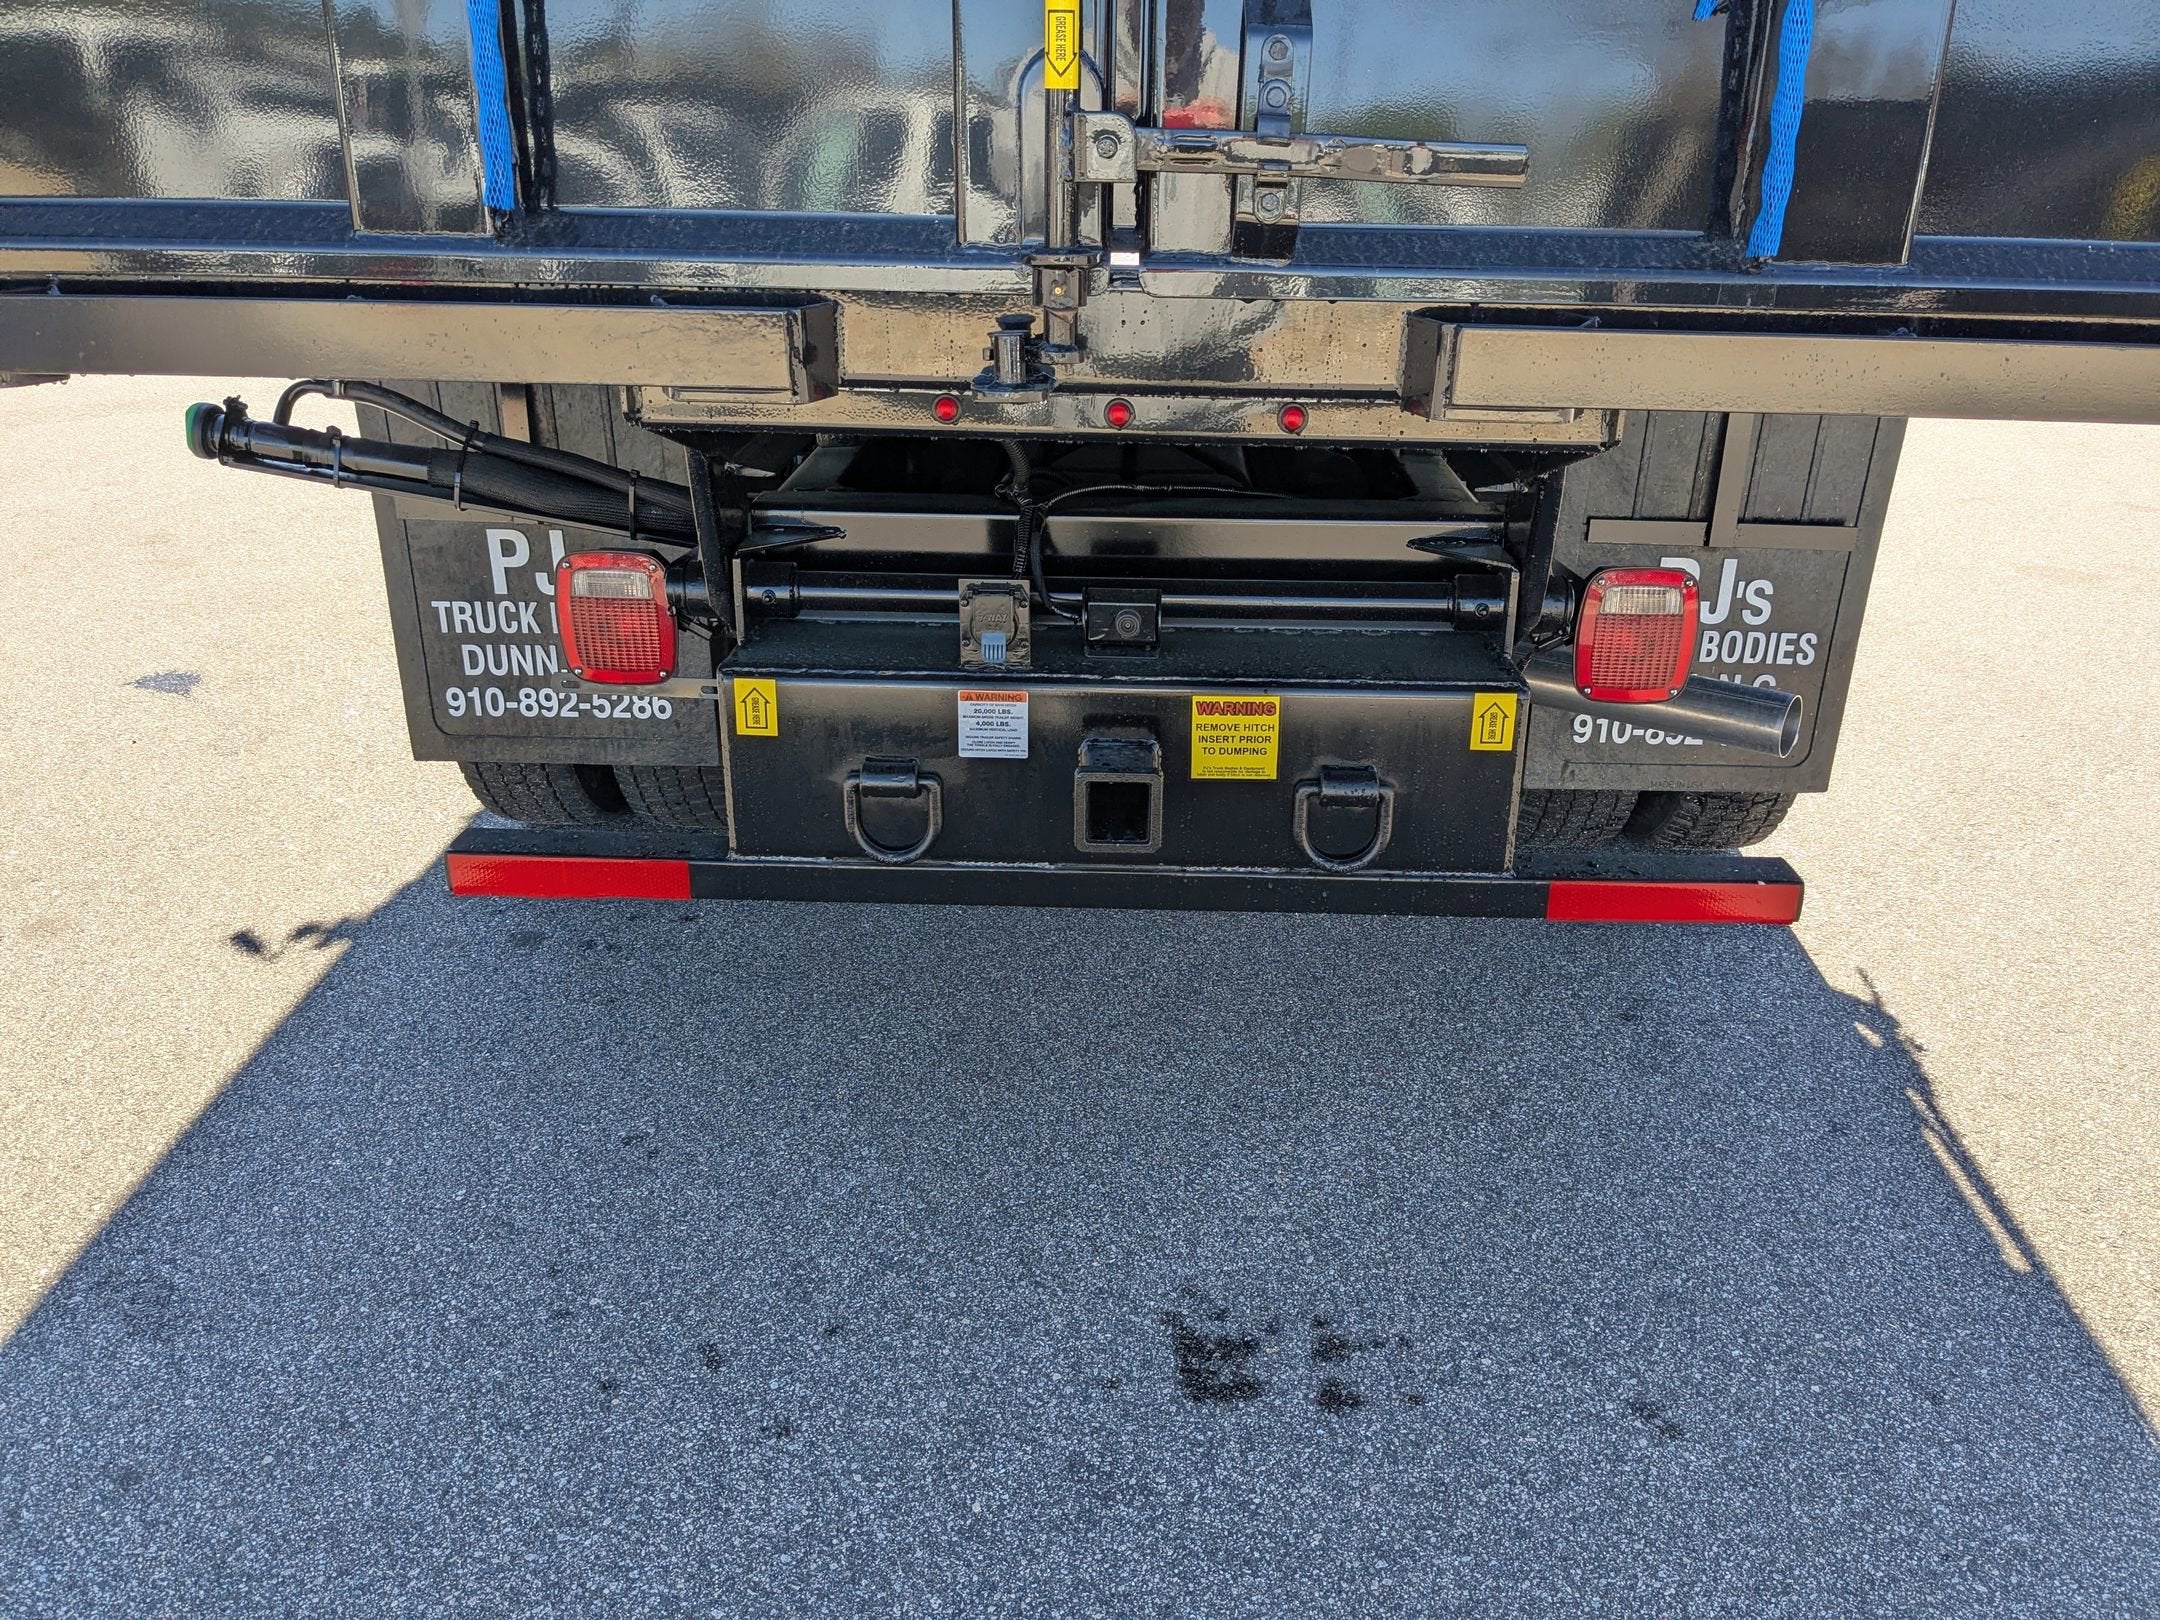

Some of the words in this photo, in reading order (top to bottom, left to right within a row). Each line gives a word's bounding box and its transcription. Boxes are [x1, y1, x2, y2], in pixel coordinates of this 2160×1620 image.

[1056, 16, 1066, 42] GREASE
[1056, 44, 1066, 61] HERE
[431, 601, 541, 634] TRUCK
[1699, 630, 1817, 665] BODIES
[461, 644, 567, 676] DUNN
[446, 687, 673, 720] 910-892-5286
[975, 693, 1023, 702] WARNING
[1196, 701, 1276, 716] WARNING
[1196, 723, 1240, 732] REMOVE
[1243, 723, 1275, 732] HITCH
[1198, 735, 1236, 743] INSERT
[1239, 735, 1271, 744] PRIOR
[1202, 747, 1216, 755] TO
[1219, 747, 1267, 755] DUMPING
